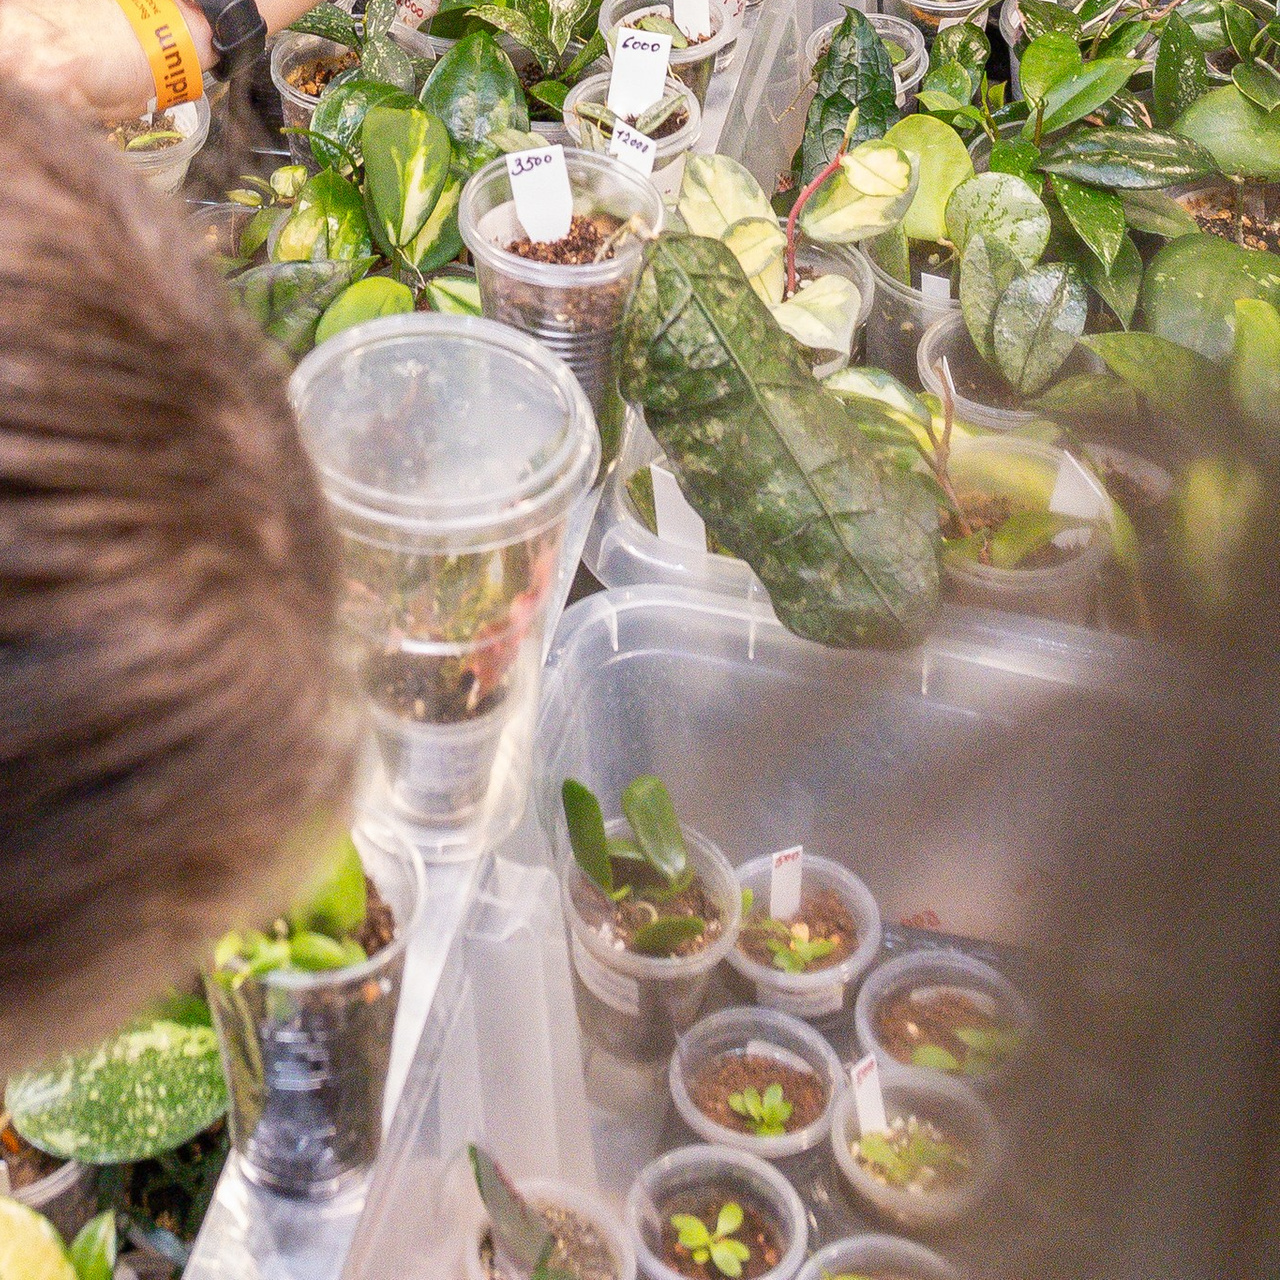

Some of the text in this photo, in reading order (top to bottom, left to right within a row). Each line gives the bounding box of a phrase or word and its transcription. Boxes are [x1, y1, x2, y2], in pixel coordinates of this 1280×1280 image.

[622, 36, 661, 52] 6000
[154, 24, 189, 104] idium
[616, 130, 650, 153] 12000
[511, 154, 552, 177] 3500
